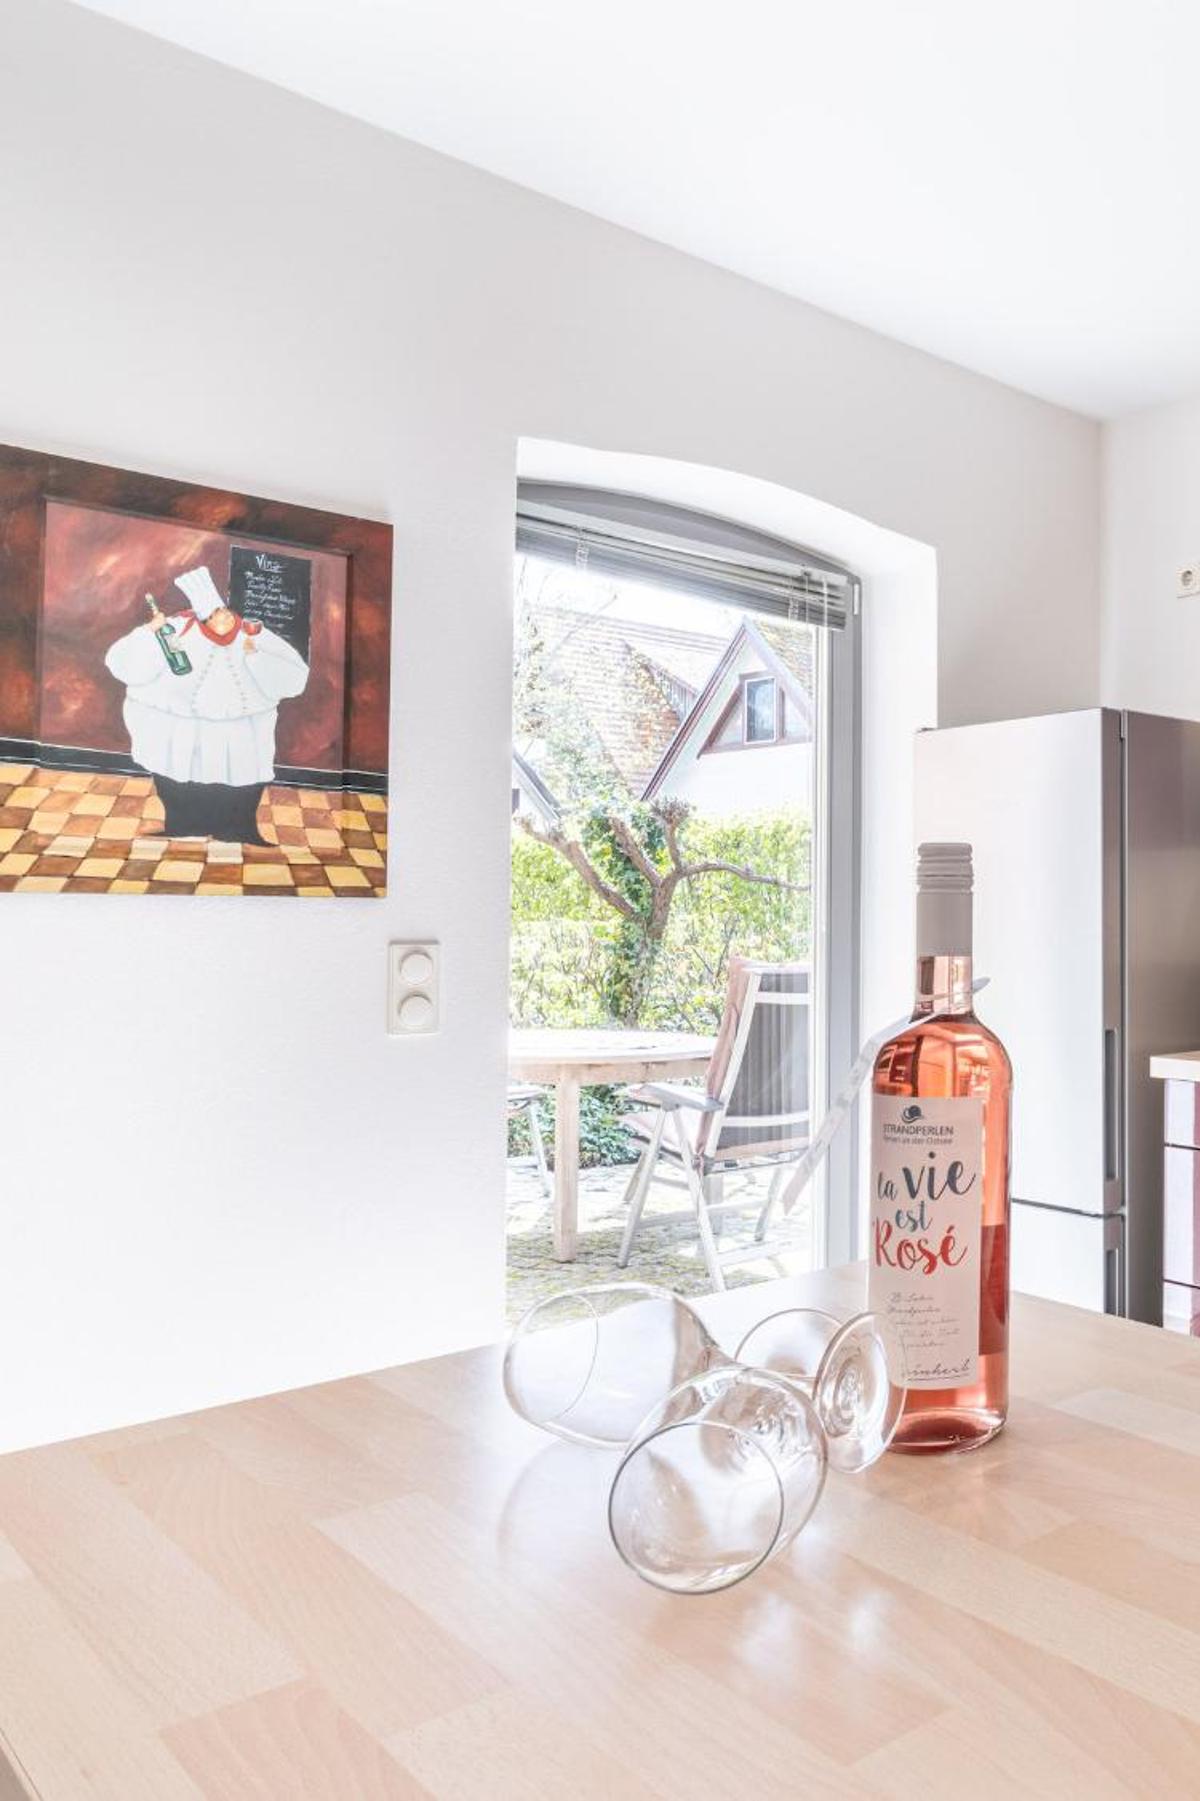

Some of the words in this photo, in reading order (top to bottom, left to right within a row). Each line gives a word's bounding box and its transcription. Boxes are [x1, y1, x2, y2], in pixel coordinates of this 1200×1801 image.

[883, 1123, 955, 1137] STRANDPERLEN
[877, 1171, 898, 1200] la
[902, 1151, 976, 1201] vie
[895, 1200, 933, 1232] est
[874, 1216, 968, 1275] Rosé
